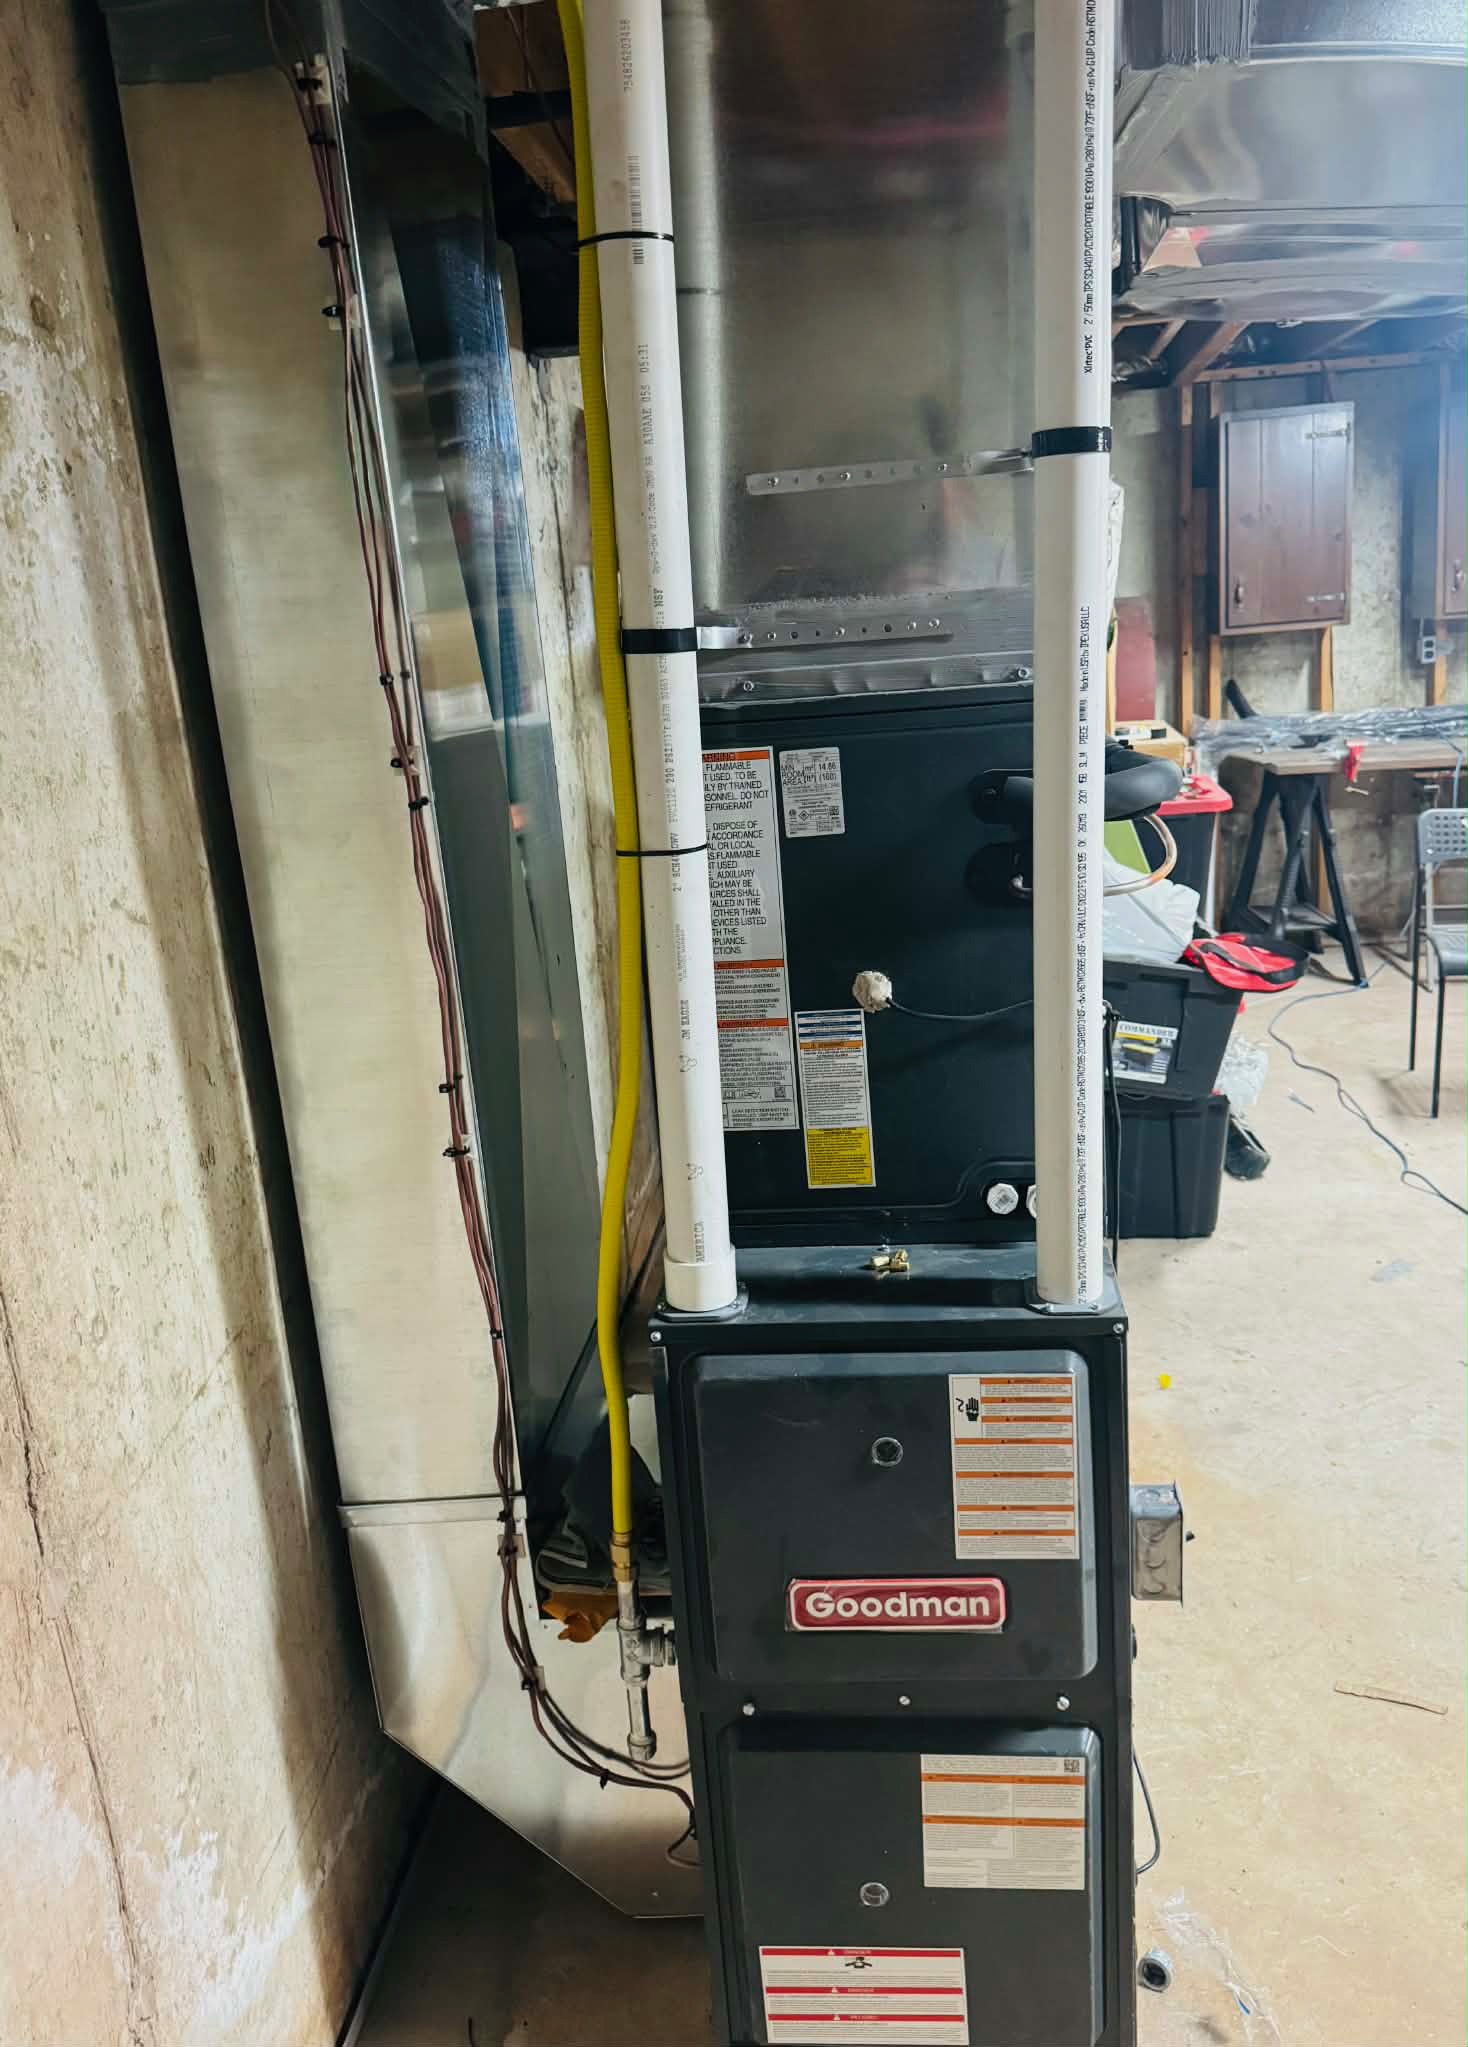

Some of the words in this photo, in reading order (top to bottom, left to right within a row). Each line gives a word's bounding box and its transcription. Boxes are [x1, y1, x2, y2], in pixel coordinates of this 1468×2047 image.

[1078, 725, 1089, 744] PIECE
[706, 761, 752, 772] FLAMMABLE
[735, 772, 746, 780] TO
[746, 770, 757, 780] BE
[717, 782, 729, 791] BY
[729, 780, 762, 790] TRAINED
[740, 791, 752, 800] DO
[753, 789, 769, 799] NOT
[704, 801, 753, 811] EFRIGERANT
[712, 821, 746, 831] DISPOSE
[747, 820, 758, 829] OF
[711, 829, 764, 841] ACCORDANCE
[730, 840, 755, 849] LOCAL
[716, 849, 761, 860] FLAMMABLE
[717, 860, 738, 870] USED
[717, 869, 755, 879] AUXILIARY
[724, 879, 741, 888] MAY
[742, 879, 753, 888] BE
[710, 889, 736, 899] URCES
[737, 888, 761, 897] SHALL
[736, 898, 745, 907] IN
[746, 897, 761, 906] THE
[713, 909, 740, 918] OTHER
[741, 907, 761, 917] THAN
[711, 918, 739, 928] EVICES
[740, 916, 767, 926] LISTED
[723, 927, 739, 936] THE
[804, 1591, 990, 1618] Goodman
